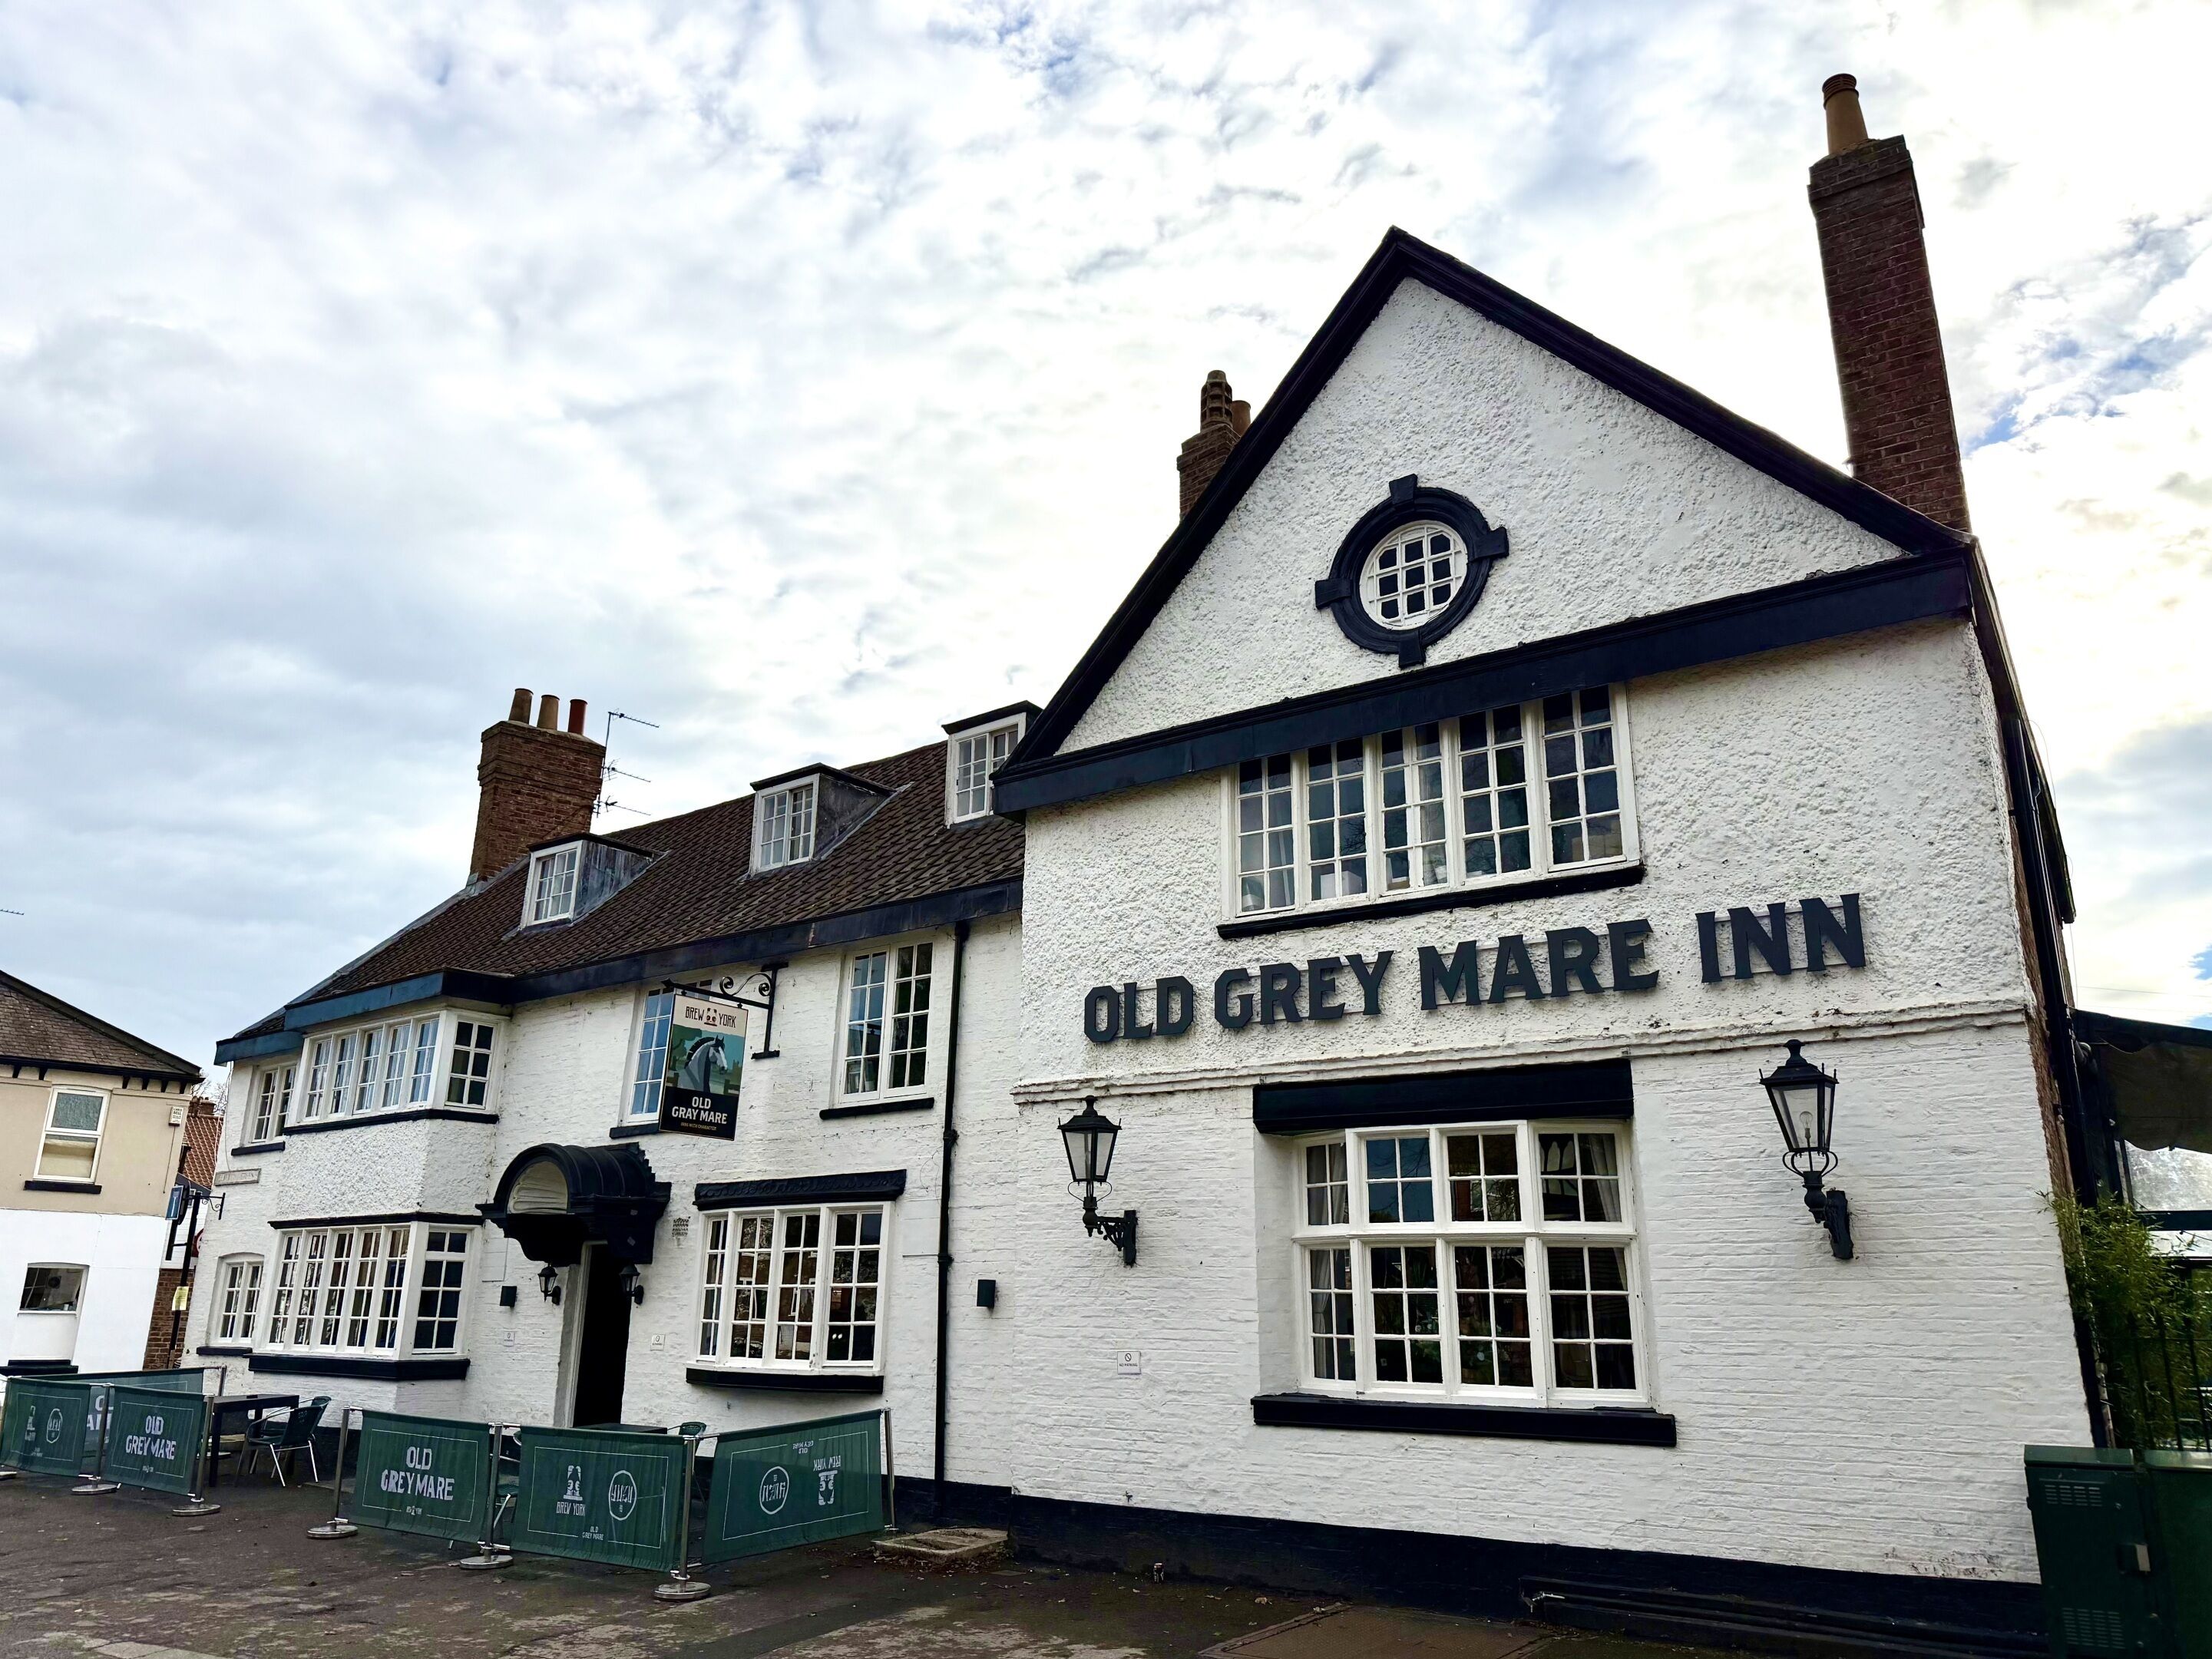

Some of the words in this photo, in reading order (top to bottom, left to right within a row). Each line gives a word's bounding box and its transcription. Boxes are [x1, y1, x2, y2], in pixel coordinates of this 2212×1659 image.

[1083, 975, 1193, 1043] OLD
[1214, 950, 1394, 1029] GREY
[1417, 918, 1661, 1010] MARE
[1695, 892, 1867, 983] INN
[685, 1006, 705, 1022] BREW
[719, 1013, 737, 1029] YORK
[692, 1096, 712, 1109] OLD
[672, 1105, 699, 1120] GRAY
[699, 1109, 728, 1125] MARE
[145, 1415, 164, 1436] OLD
[125, 1435, 151, 1456] GREY
[150, 1437, 177, 1461] MARE
[406, 1446, 432, 1471] OLD
[380, 1469, 415, 1495] GREY
[415, 1473, 455, 1501] MARE
[556, 1502, 571, 1515] BREW
[573, 1502, 586, 1517] YORK
